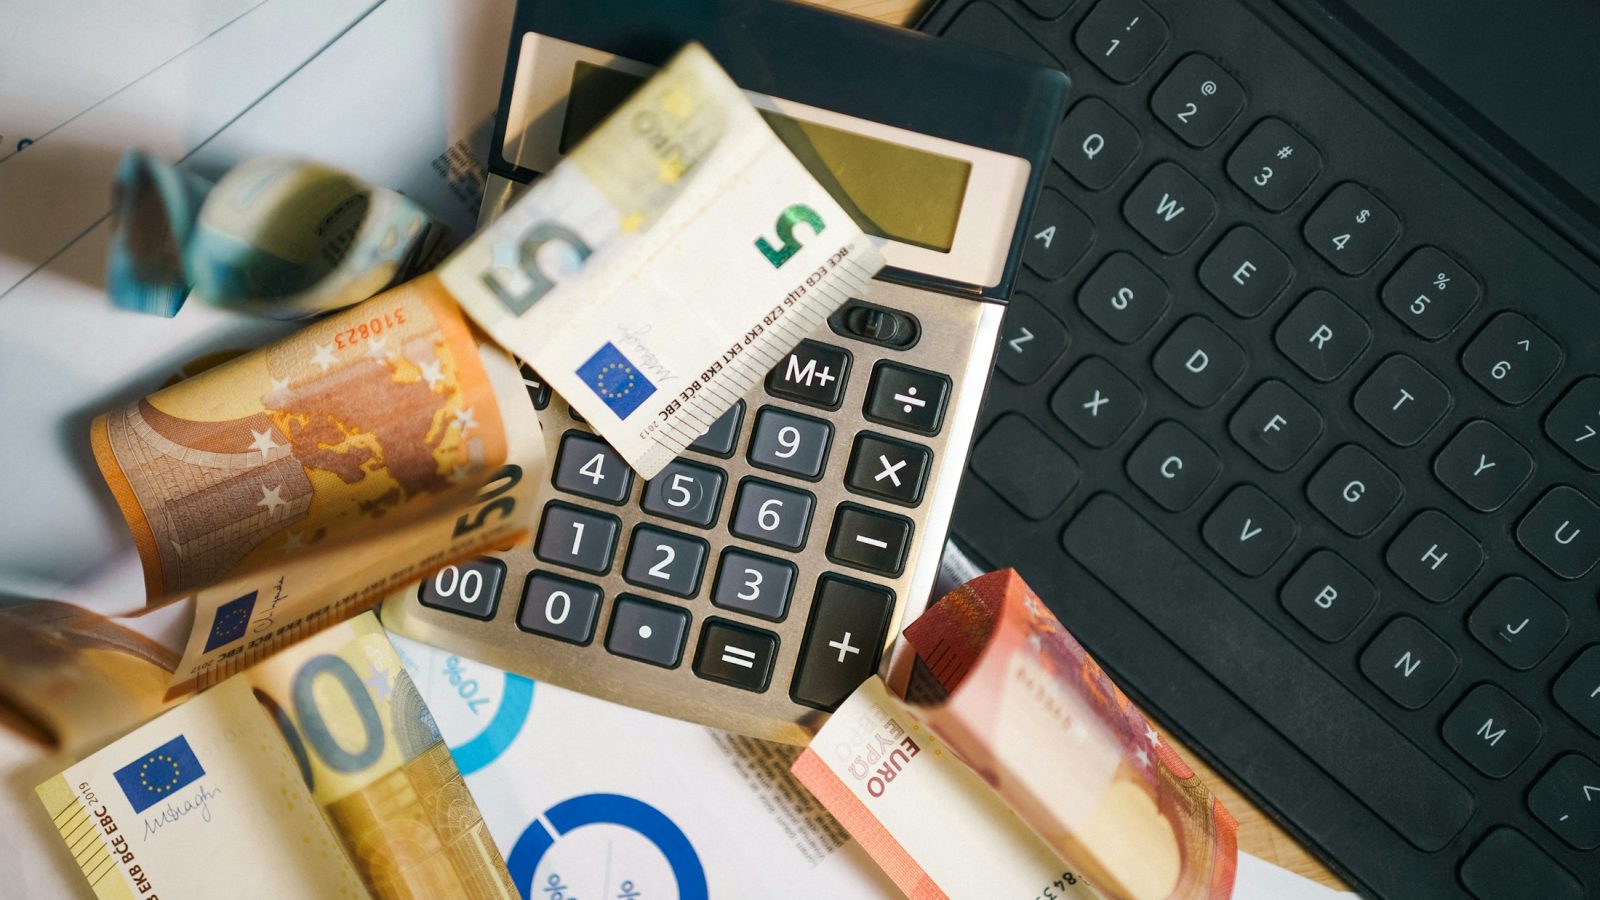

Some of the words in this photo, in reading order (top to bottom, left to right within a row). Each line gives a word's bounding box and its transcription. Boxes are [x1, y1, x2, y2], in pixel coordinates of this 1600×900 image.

[1106, 40, 1120, 56] 1
[1178, 103, 1196, 123] 2
[1083, 134, 1104, 159] Q
[1254, 167, 1272, 185] 3
[1157, 194, 1184, 221] W
[753, 203, 826, 269] 5
[1035, 226, 1056, 248] A
[1333, 234, 1350, 250] 4
[477, 219, 593, 318] 5
[805, 266, 827, 287] ECB
[1233, 261, 1256, 284] E
[1112, 288, 1133, 309] S
[1411, 295, 1430, 314] 5
[763, 305, 784, 325] EZB
[334, 308, 406, 349] 310823
[744, 324, 763, 344] EKP
[1010, 328, 1034, 352] Z
[1310, 325, 1332, 349] R
[722, 343, 743, 363] EKT
[1186, 350, 1208, 372] D
[700, 361, 722, 382] EKB
[784, 354, 836, 387] M+
[1492, 361, 1510, 379] 6
[658, 399, 681, 420] EBC
[1084, 390, 1109, 416] X
[1394, 389, 1414, 410] T
[639, 420, 658, 439] 2013
[1264, 415, 1286, 431] F
[1576, 425, 1596, 441] 7
[775, 427, 800, 458] 9
[580, 454, 604, 484] 4
[1161, 456, 1182, 478] C
[1474, 455, 1495, 475] Y
[453, 464, 523, 537] 50
[668, 474, 693, 506] 5
[1343, 481, 1365, 502] G
[758, 500, 783, 530] 6
[572, 522, 584, 554] 1
[1241, 519, 1261, 540] V
[1555, 521, 1580, 544] U
[649, 545, 675, 579] 2
[1421, 544, 1448, 569] H
[435, 566, 482, 603] 00
[737, 569, 762, 600] 3
[545, 591, 570, 624] 0
[1315, 585, 1337, 608] B
[1507, 619, 1529, 634] J
[217, 645, 246, 662] EBC
[1395, 652, 1420, 676] N
[441, 655, 490, 716] 70%
[1477, 719, 1506, 746] M
[867, 736, 921, 797] EURO
[78, 782, 98, 805] 2019
[94, 805, 117, 835] EBC
[128, 864, 151, 893] EKB
